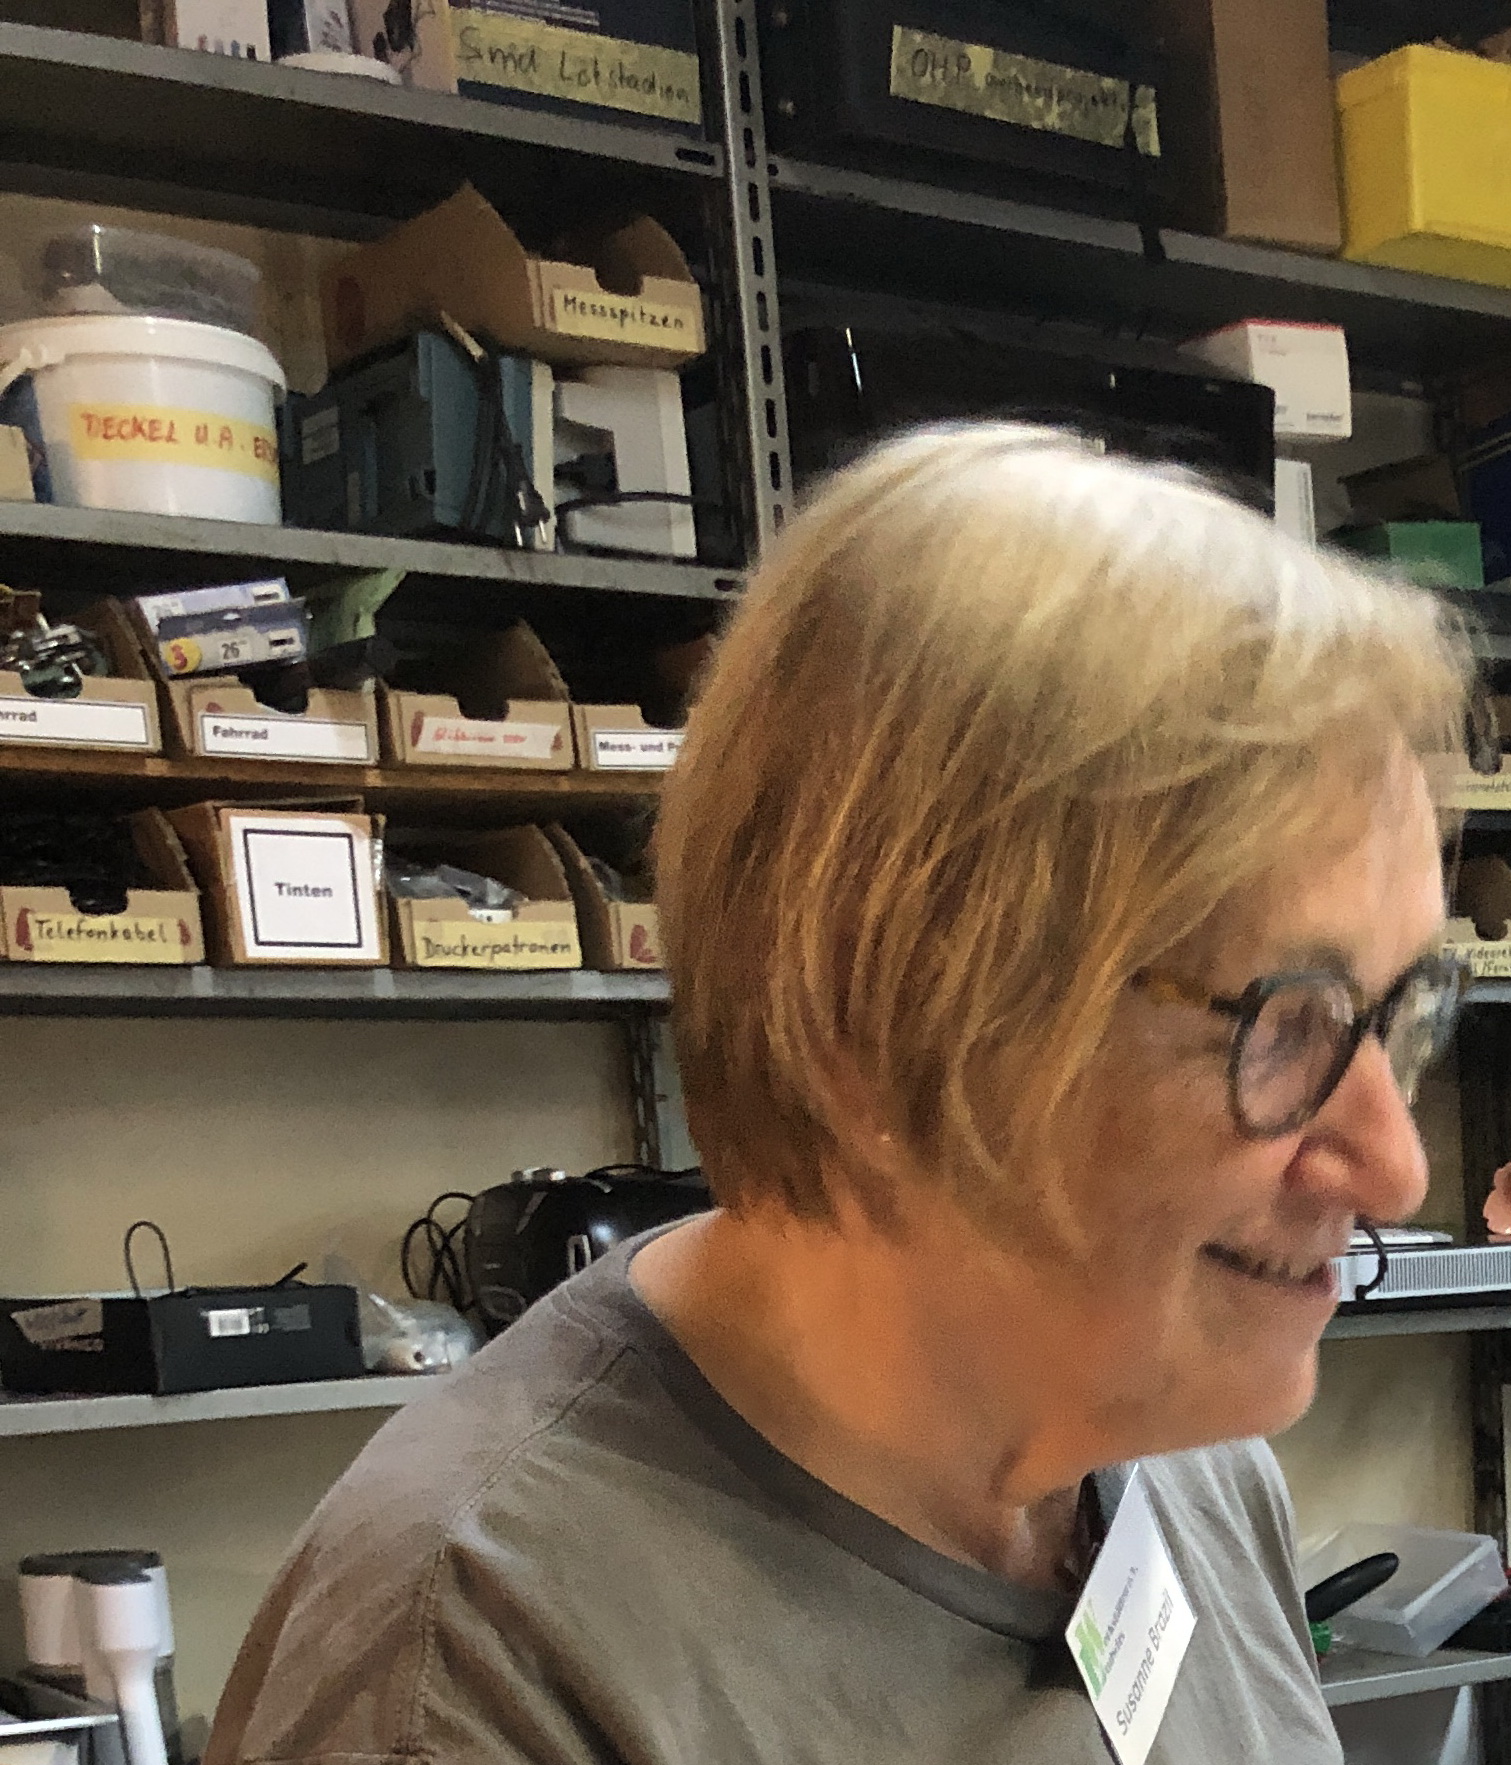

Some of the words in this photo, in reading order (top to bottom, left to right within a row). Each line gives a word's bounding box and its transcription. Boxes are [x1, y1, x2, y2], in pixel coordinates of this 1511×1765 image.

[81, 412, 180, 444] DECKEL
[212, 725, 269, 741] Fahrrad
[640, 742, 663, 752] und
[274, 882, 334, 899] Tinten
[35, 918, 168, 943] Telefonkabel
[421, 933, 572, 960] Druckerpatronen
[1115, 1647, 1156, 1737] Susanne
